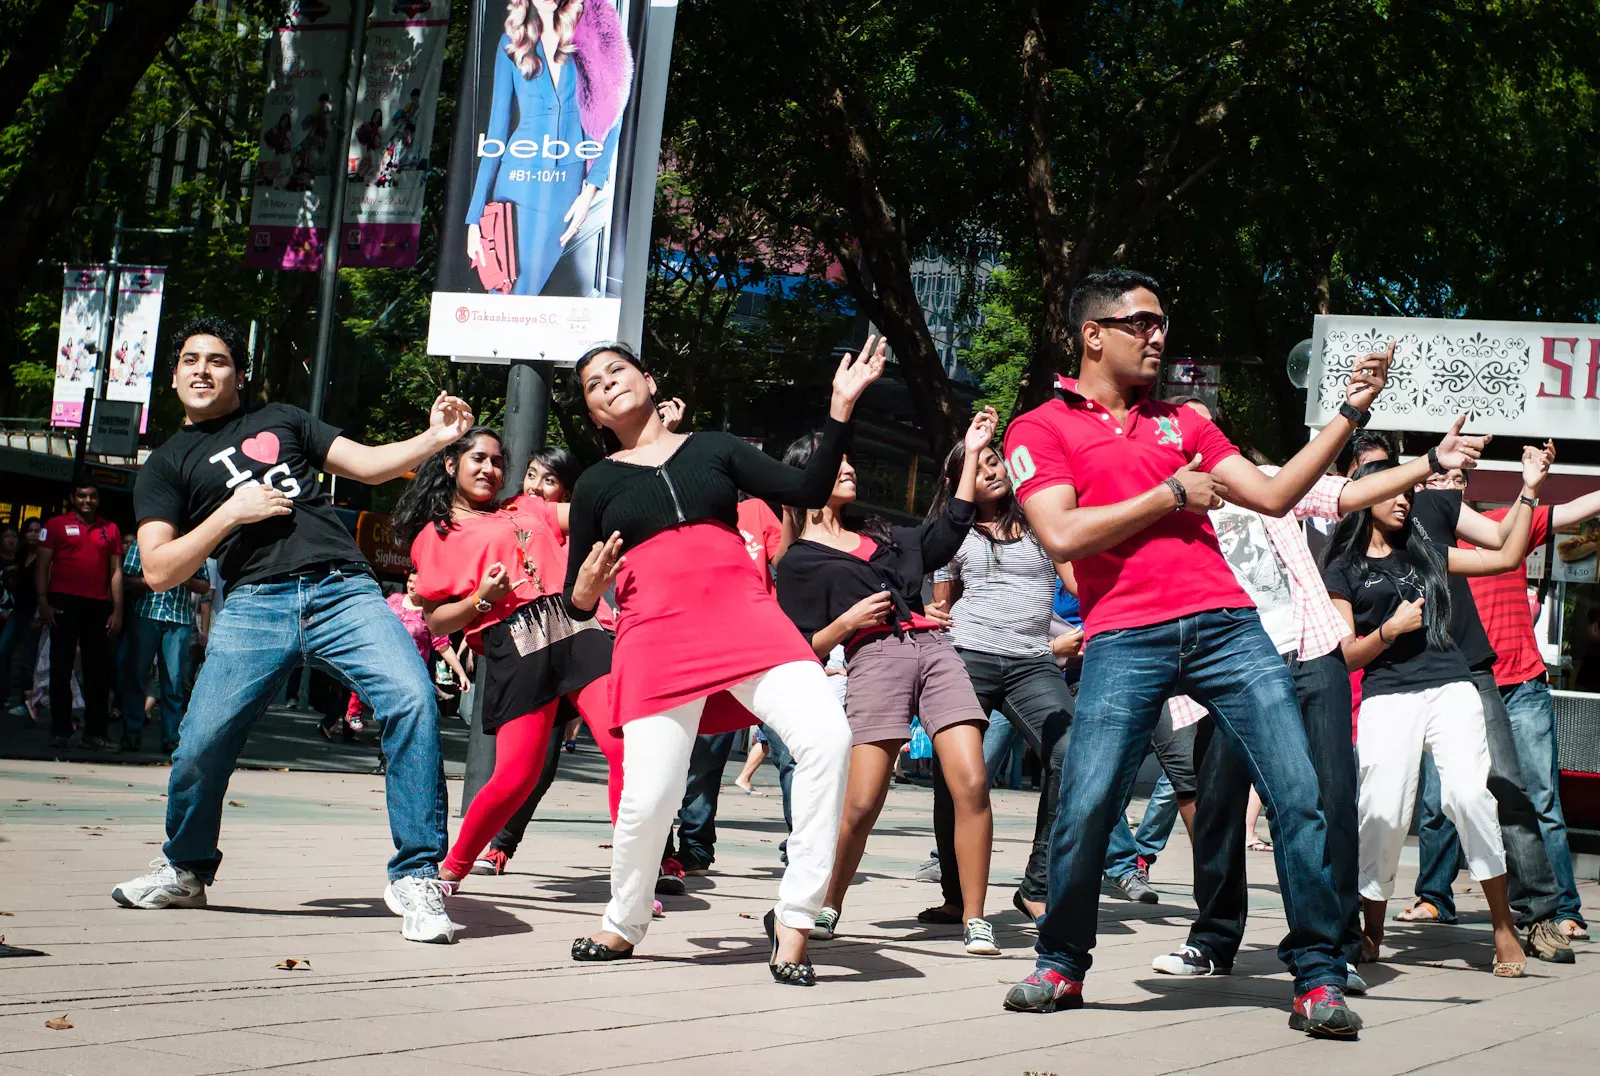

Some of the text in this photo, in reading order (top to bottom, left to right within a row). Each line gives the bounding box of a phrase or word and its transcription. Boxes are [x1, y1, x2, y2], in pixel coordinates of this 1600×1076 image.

[363, 91, 389, 102] 2012
[476, 133, 604, 160] bebe
[508, 170, 566, 183] #B1-10/11
[361, 197, 377, 206] May
[471, 311, 538, 326] Takashimaya
[539, 314, 559, 325] S.C.
[209, 446, 253, 488] I
